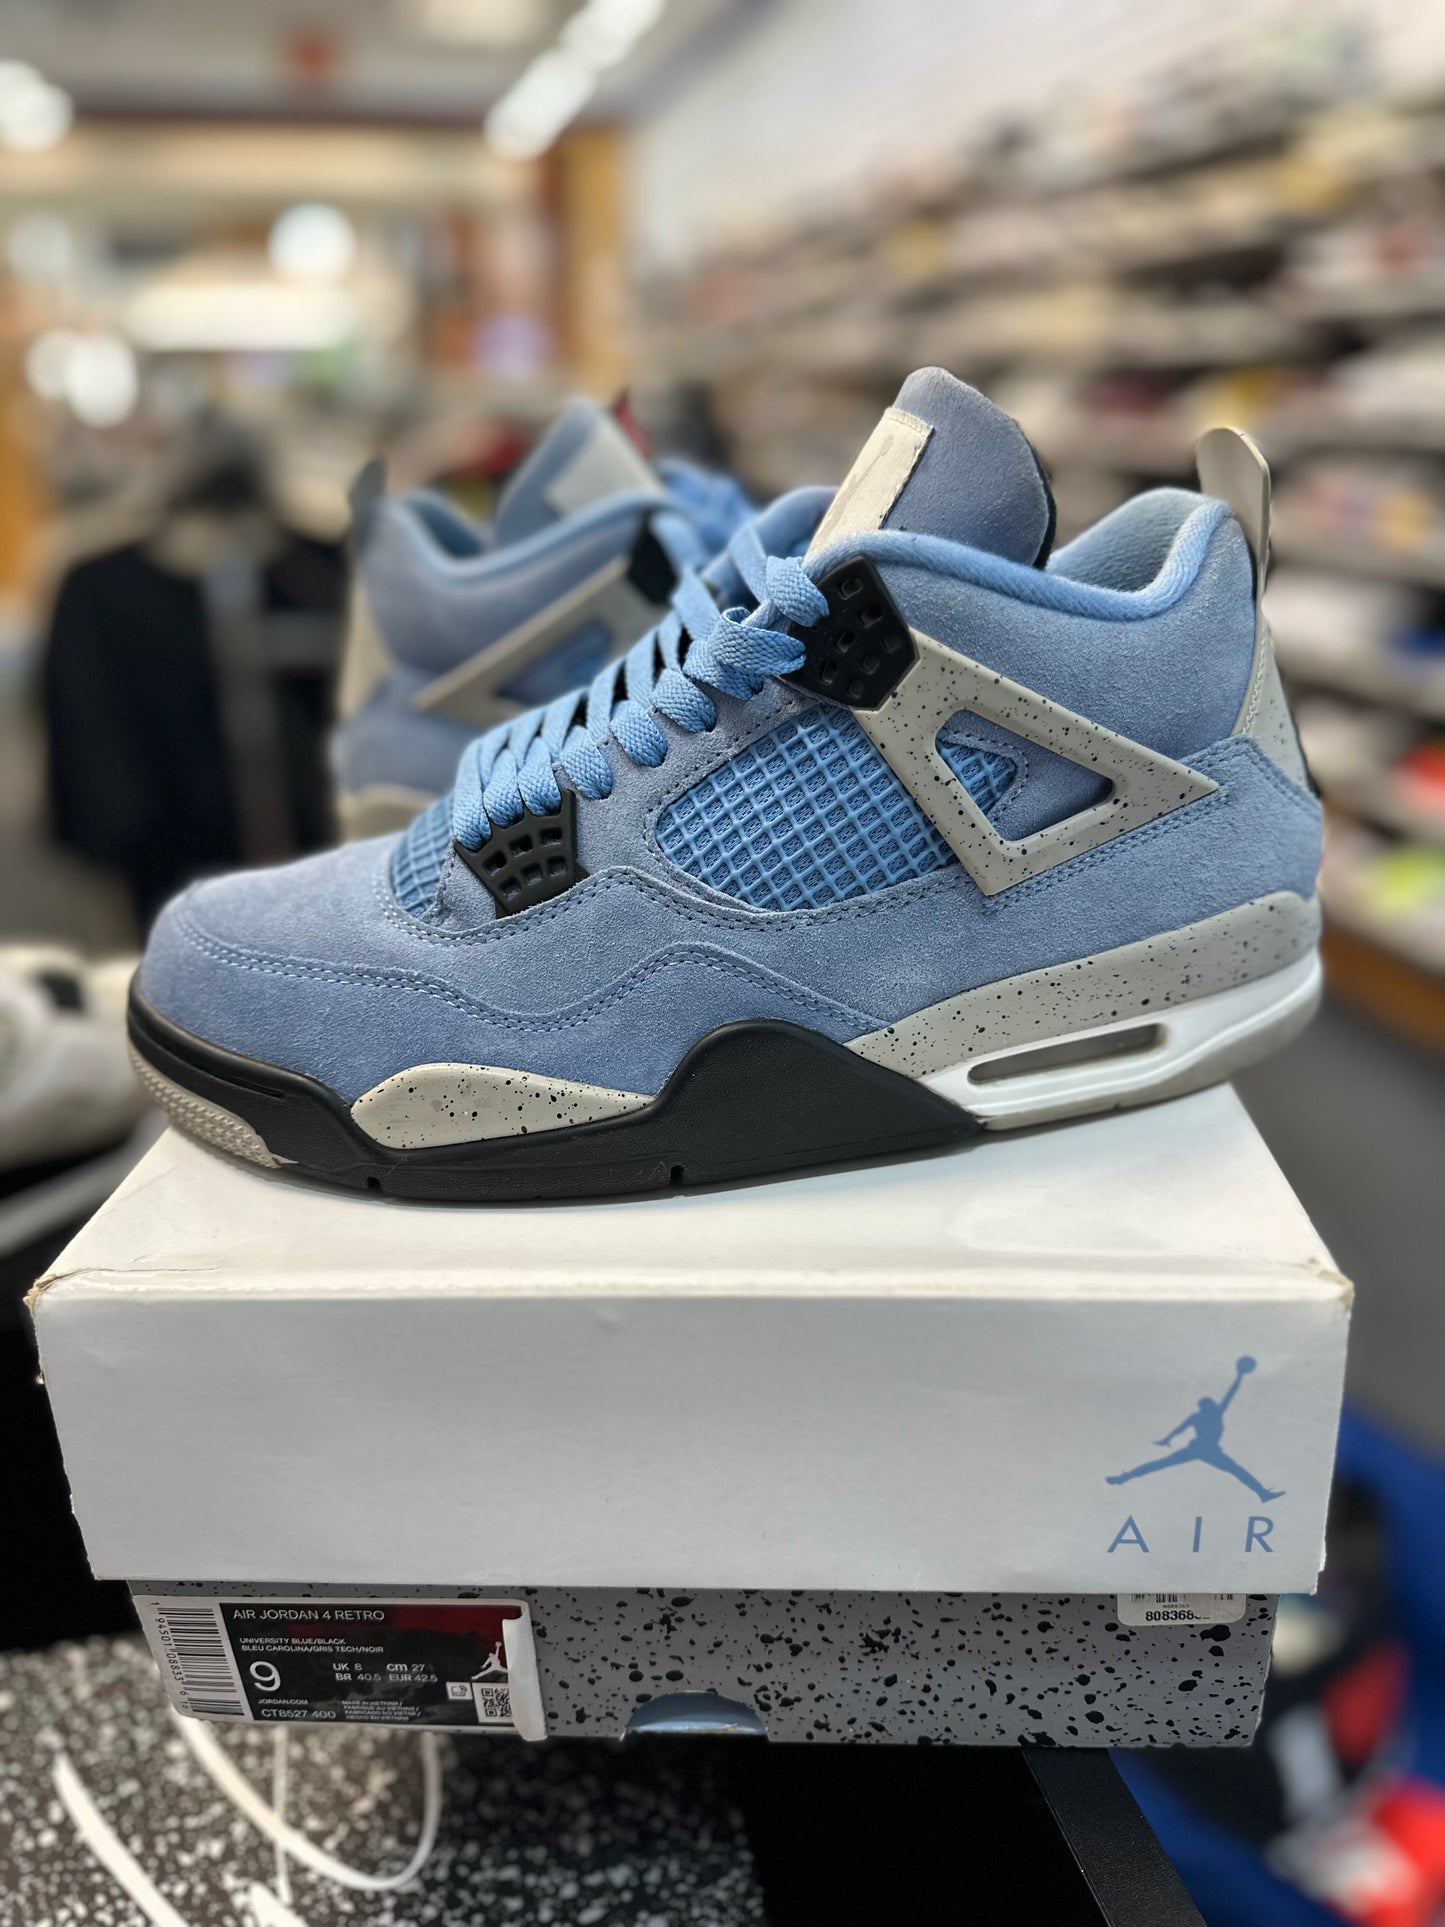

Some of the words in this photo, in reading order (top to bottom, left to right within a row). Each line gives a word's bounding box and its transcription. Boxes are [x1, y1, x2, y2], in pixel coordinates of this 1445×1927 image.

[1107, 1515, 1274, 1553] AIR
[233, 1609, 257, 1620] AIR
[259, 1609, 319, 1621] JORDAN
[322, 1609, 332, 1621] 4
[334, 1609, 385, 1621] RETRO
[1145, 1609, 1211, 1621] 808368
[291, 1637, 347, 1645] BLUE/BLACK
[155, 1617, 172, 1646] 94501
[166, 1653, 184, 1681] 08833
[265, 1645, 334, 1653] CAROLINA/GRIS
[335, 1645, 385, 1653] TECH/NOIR
[332, 1662, 350, 1671] UK
[354, 1662, 363, 1671] 8
[411, 1663, 426, 1672] 27
[250, 1660, 281, 1692] 9
[335, 1672, 353, 1681] BR
[357, 1673, 382, 1682] 40.5
[388, 1673, 412, 1682] EUR
[414, 1673, 438, 1683] 42.5
[261, 1708, 308, 1719] CT8527
[312, 1710, 337, 1720] 400
